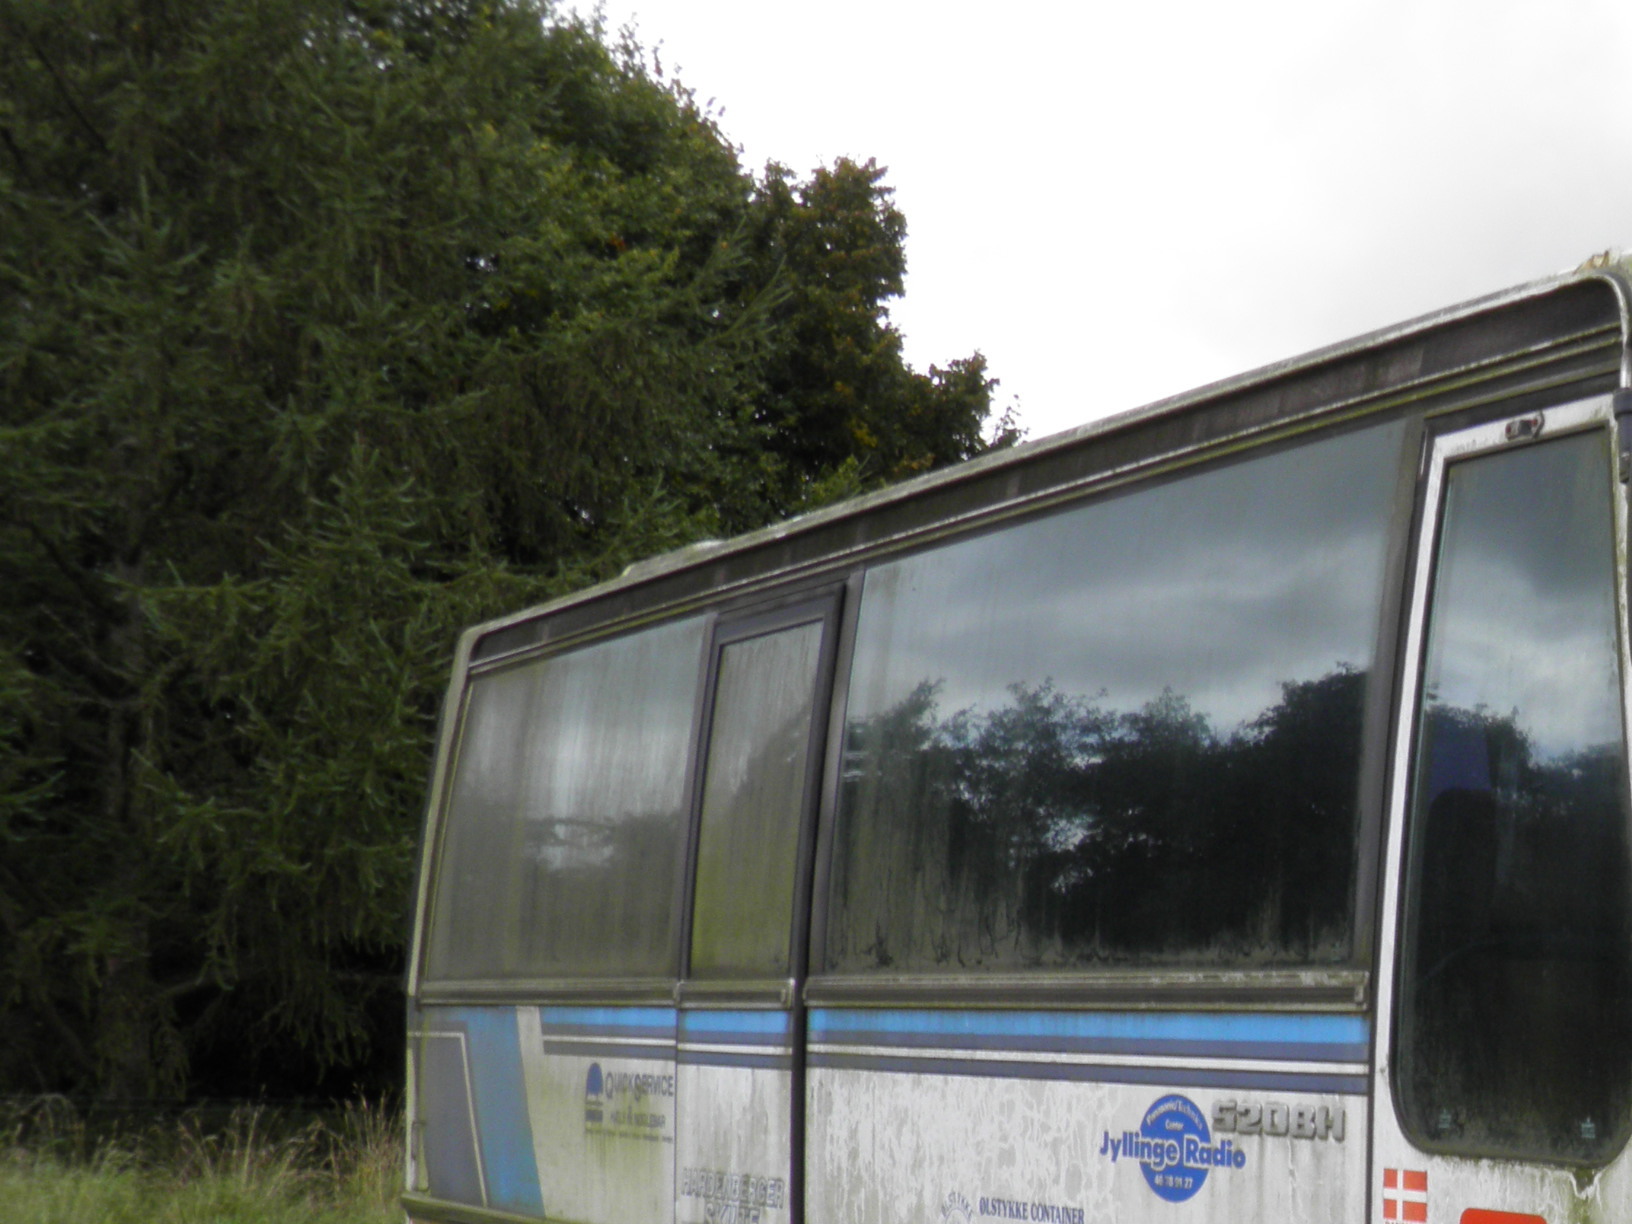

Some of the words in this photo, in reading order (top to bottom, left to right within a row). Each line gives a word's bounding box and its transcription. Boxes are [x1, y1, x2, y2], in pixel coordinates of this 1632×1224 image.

[1100, 1131, 1181, 1170] Jyllinge
[1183, 1133, 1246, 1169] Radio
[979, 1197, 1028, 1221] ØLSTYKKE
